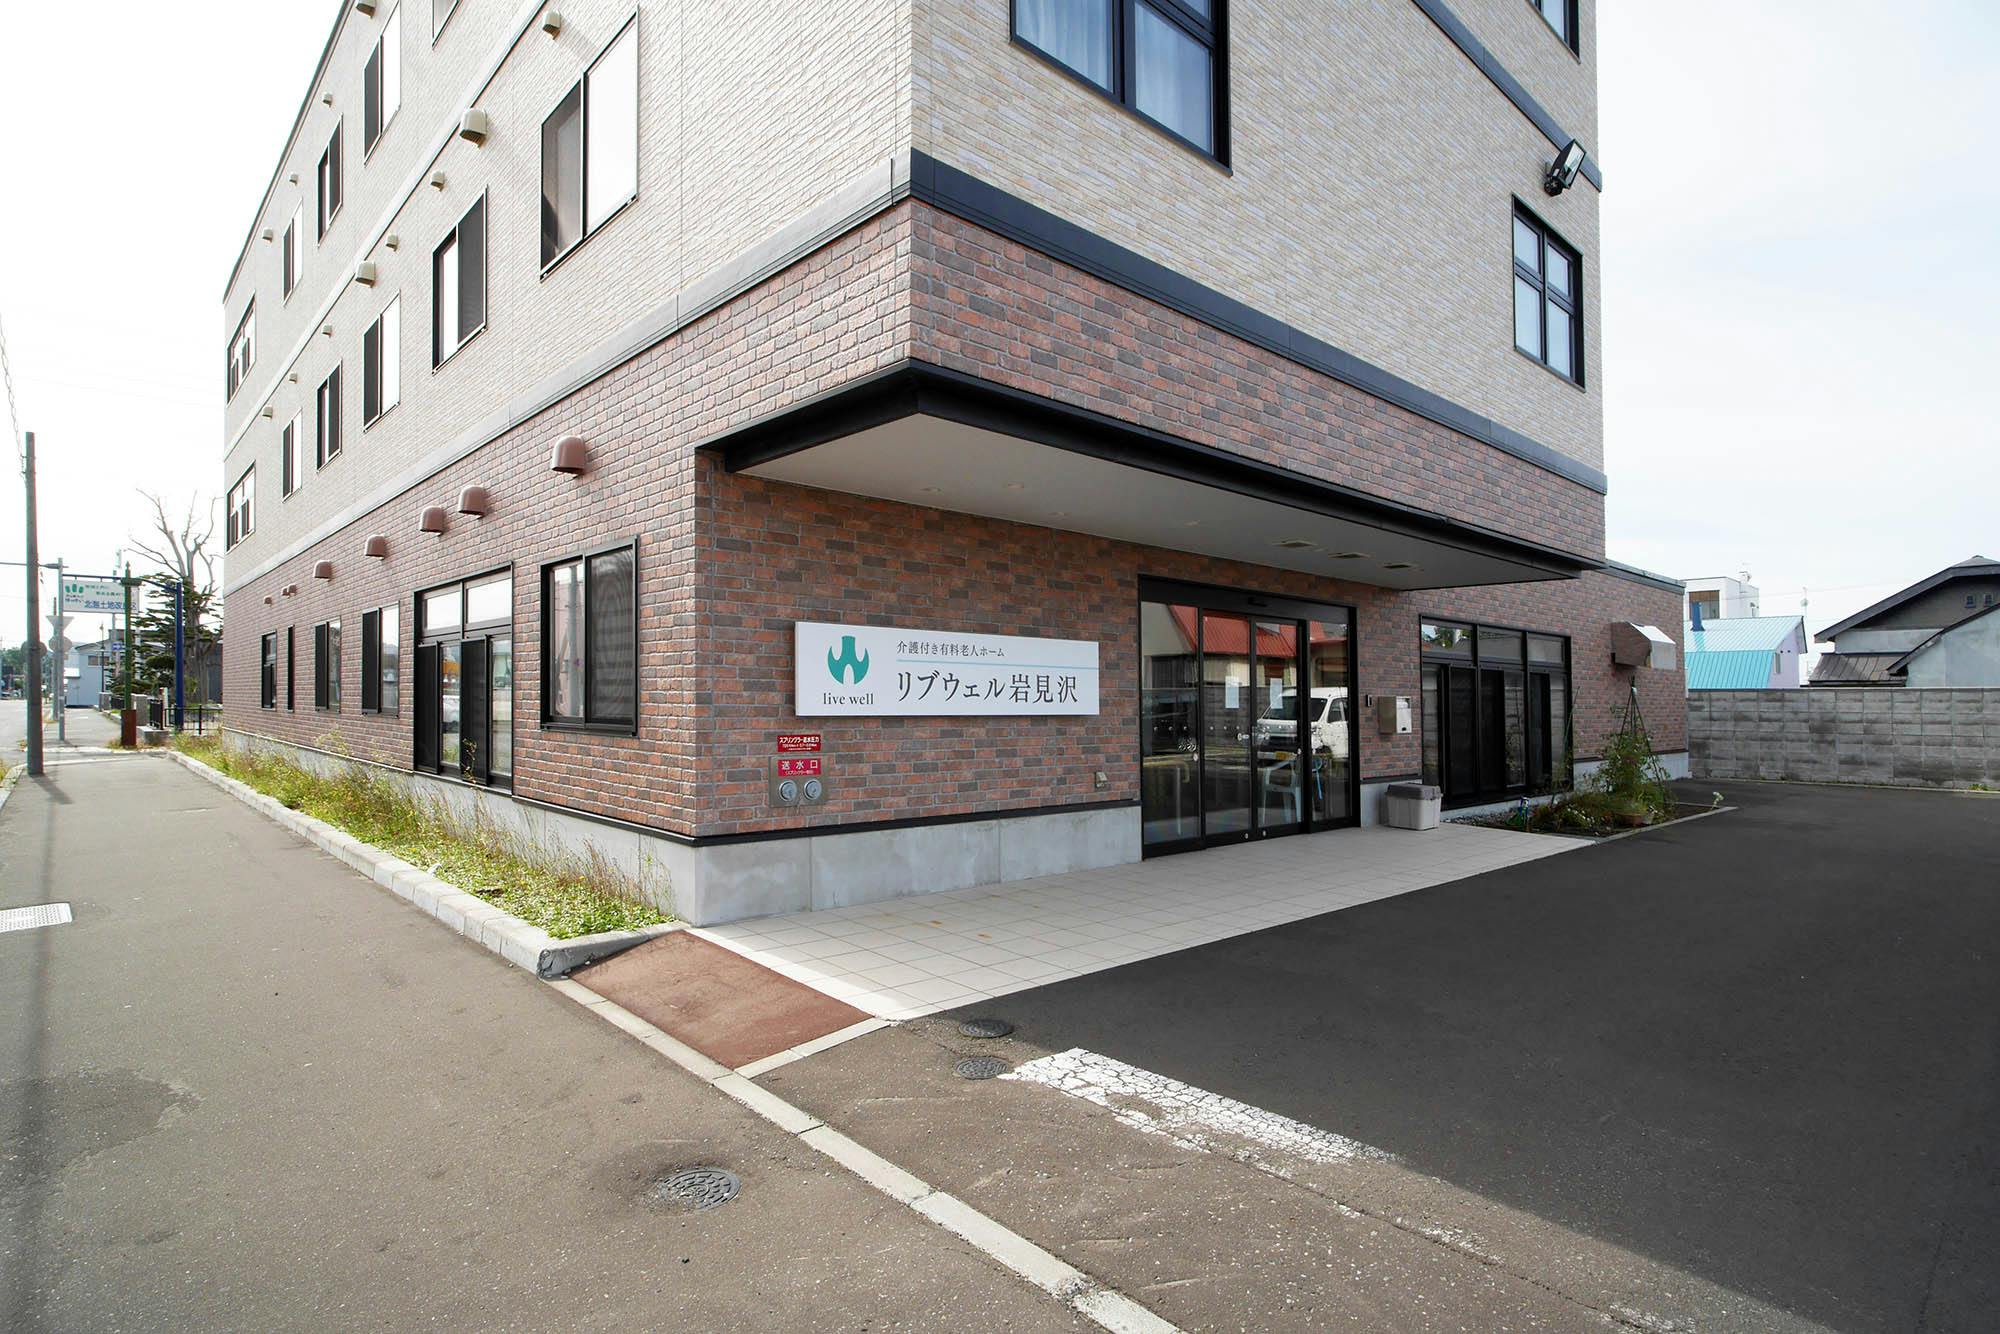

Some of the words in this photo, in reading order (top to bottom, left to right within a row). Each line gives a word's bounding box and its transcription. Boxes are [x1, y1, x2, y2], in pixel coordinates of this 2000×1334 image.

[84, 600, 137, 610] 北海土地改区
[896, 640, 1005, 657] 介護付き有料老人ホーム
[897, 669, 1079, 704] リブウェル岩見沢
[823, 692, 846, 705] live
[849, 692, 874, 705] well
[782, 760, 818, 770] 送水口
